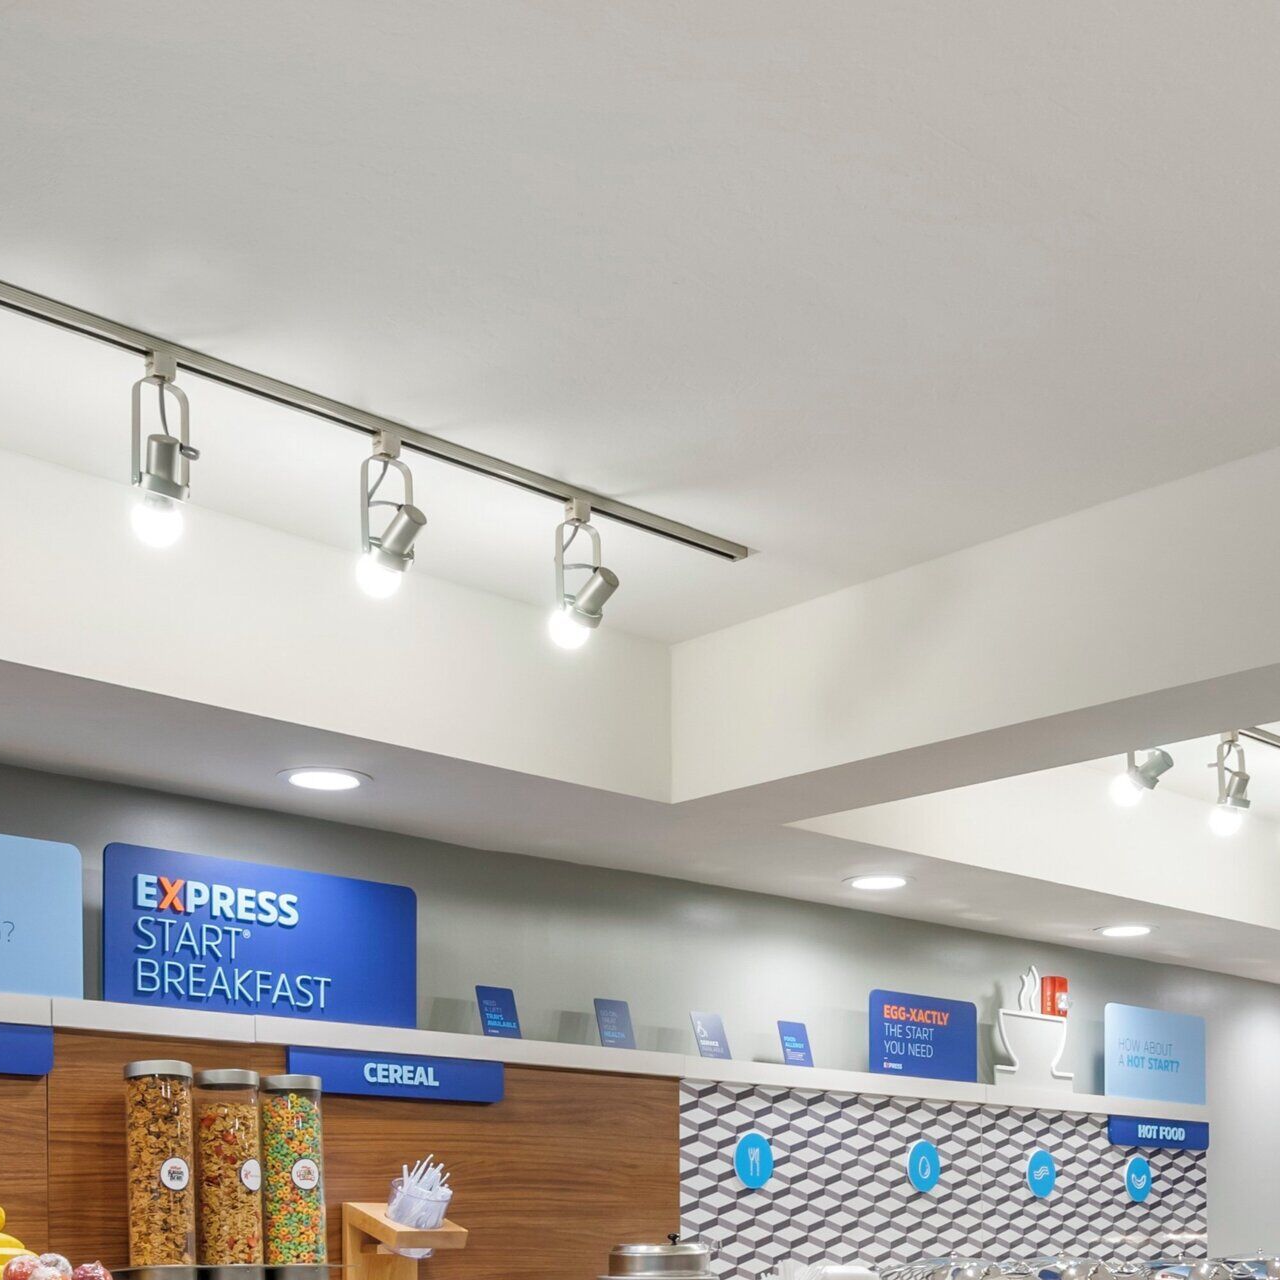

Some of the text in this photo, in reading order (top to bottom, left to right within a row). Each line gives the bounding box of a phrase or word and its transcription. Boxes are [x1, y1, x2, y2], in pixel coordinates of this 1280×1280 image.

[136, 873, 300, 926] EXPRESS
[136, 957, 332, 1009] BREAKFAST
[883, 1004, 950, 1026] EGG-XACTLY
[883, 1022, 935, 1041] THE START
[883, 1039, 934, 1058] YOU NEED
[1118, 1038, 1173, 1057] HOW ABOUT
[1118, 1054, 1180, 1073] A HOT START?
[363, 1062, 439, 1087] CEREAL
[1137, 1124, 1186, 1141] HOT FOOD
